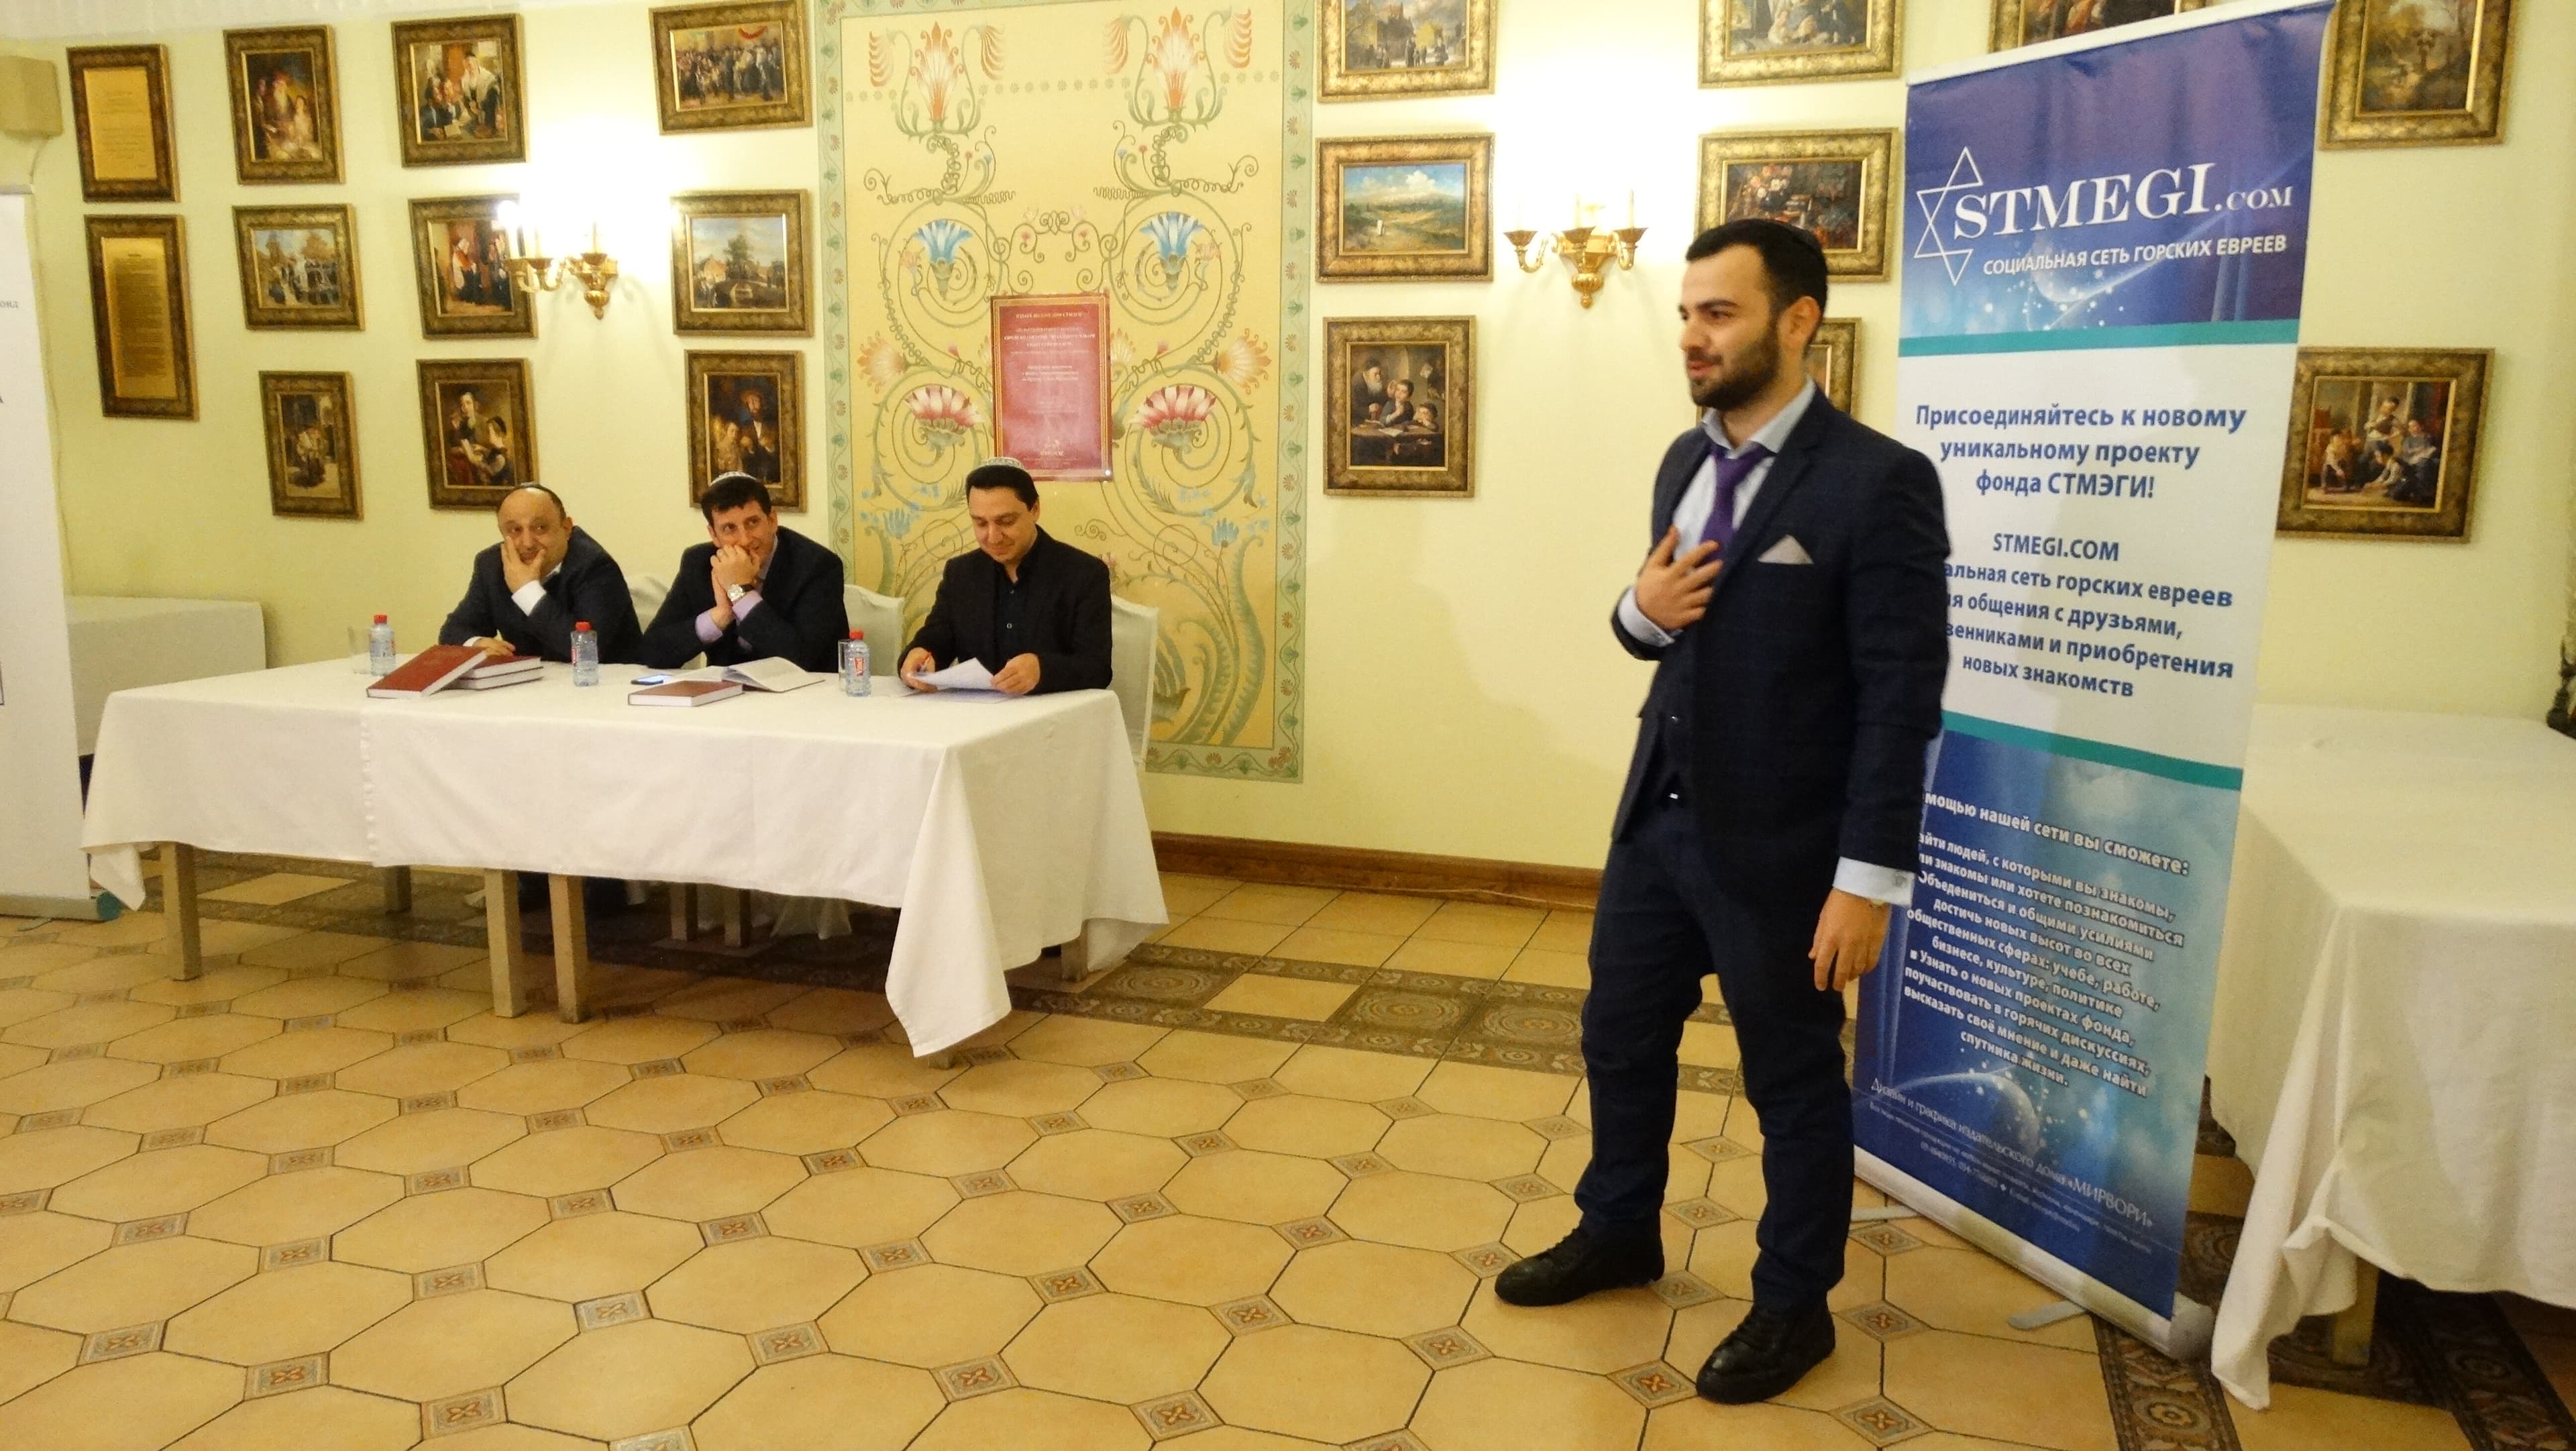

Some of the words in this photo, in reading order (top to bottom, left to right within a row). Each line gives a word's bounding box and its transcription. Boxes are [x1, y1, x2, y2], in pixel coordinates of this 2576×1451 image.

[1954, 162, 2293, 239] STMEGI.COM
[1983, 252, 2087, 275] СОЦИАЛЬНАЯ
[2090, 247, 2130, 267] СЕТЬ
[2134, 239, 2212, 263] ГОРСКИХ
[2216, 235, 2287, 255] ЕВРЕЕВ
[1916, 403, 2114, 430] Присоединяйтесь
[2122, 409, 2135, 426] к
[2143, 408, 2247, 433] новому
[1940, 440, 2090, 466] уникальному
[2096, 444, 2200, 469] проекту
[1976, 470, 2041, 496] фонда
[2047, 473, 2155, 498] СТМЭГИ!
[1993, 533, 2120, 561] STMEGI.COM
[1968, 592, 2049, 620] общения
[2055, 607, 2064, 621] с
[2068, 607, 2184, 639] друзьями,
[2011, 571, 2051, 588] сеть
[2057, 575, 2143, 598] горских
[2148, 584, 2233, 607] евреев
[1963, 656, 2018, 678] новых
[2023, 665, 2134, 697] знакомств
[2049, 637, 2061, 652] и
[2066, 640, 2234, 678] приобретения
[1980, 807, 2031, 832] нашей
[2033, 822, 2070, 843] сети
[2074, 832, 2101, 851] вы
[2104, 839, 2190, 875] сможете:
[1935, 859, 1988, 885] знакомы
[1990, 874, 2015, 893] или
[2065, 898, 2184, 947] познакомиться
[1947, 841, 1990, 865] людей,
[1992, 856, 2000, 867] с
[2002, 858, 2072, 890] которыми
[2076, 879, 2097, 896] вы
[2100, 886, 2176, 922] знакомы,
[1907, 908, 1996, 951] общественных
[1998, 943, 2050, 969] сферах:
[2052, 961, 2099, 987] учебе,
[2102, 979, 2160, 1012] работе,
[1933, 898, 1982, 924] достичь
[1985, 916, 2028, 939] новых
[2030, 930, 2071, 955] высот
[2074, 945, 2092, 962] во
[2096, 953, 2131, 975] всех
[2008, 902, 2017, 914] и
[2019, 906, 2076, 935] общими
[2080, 928, 2153, 961] усилиями
[1905, 966, 1992, 1014] поучаствовать
[1994, 1004, 2002, 1015] в
[2004, 1008, 2059, 1037] горячих
[1919, 950, 1958, 976] Узнать
[1960, 970, 1969, 981] о
[1971, 973, 2012, 999] новых
[2015, 989, 2078, 1025] проектах
[2082, 1013, 2135, 1047] фонда,
[1932, 936, 1984, 967] бизнесе,
[1986, 957, 2050, 989] культуре,
[2052, 981, 2123, 1018] политике
[1904, 986, 1965, 1020] высказать
[1967, 1012, 1994, 1032] своё
[1997, 1025, 2047, 1054] мнение
[2050, 1047, 2059, 1061] и
[2061, 1051, 2099, 1078] даже
[2102, 1069, 2147, 1097] найти
[1960, 1030, 2019, 1065] спутника
